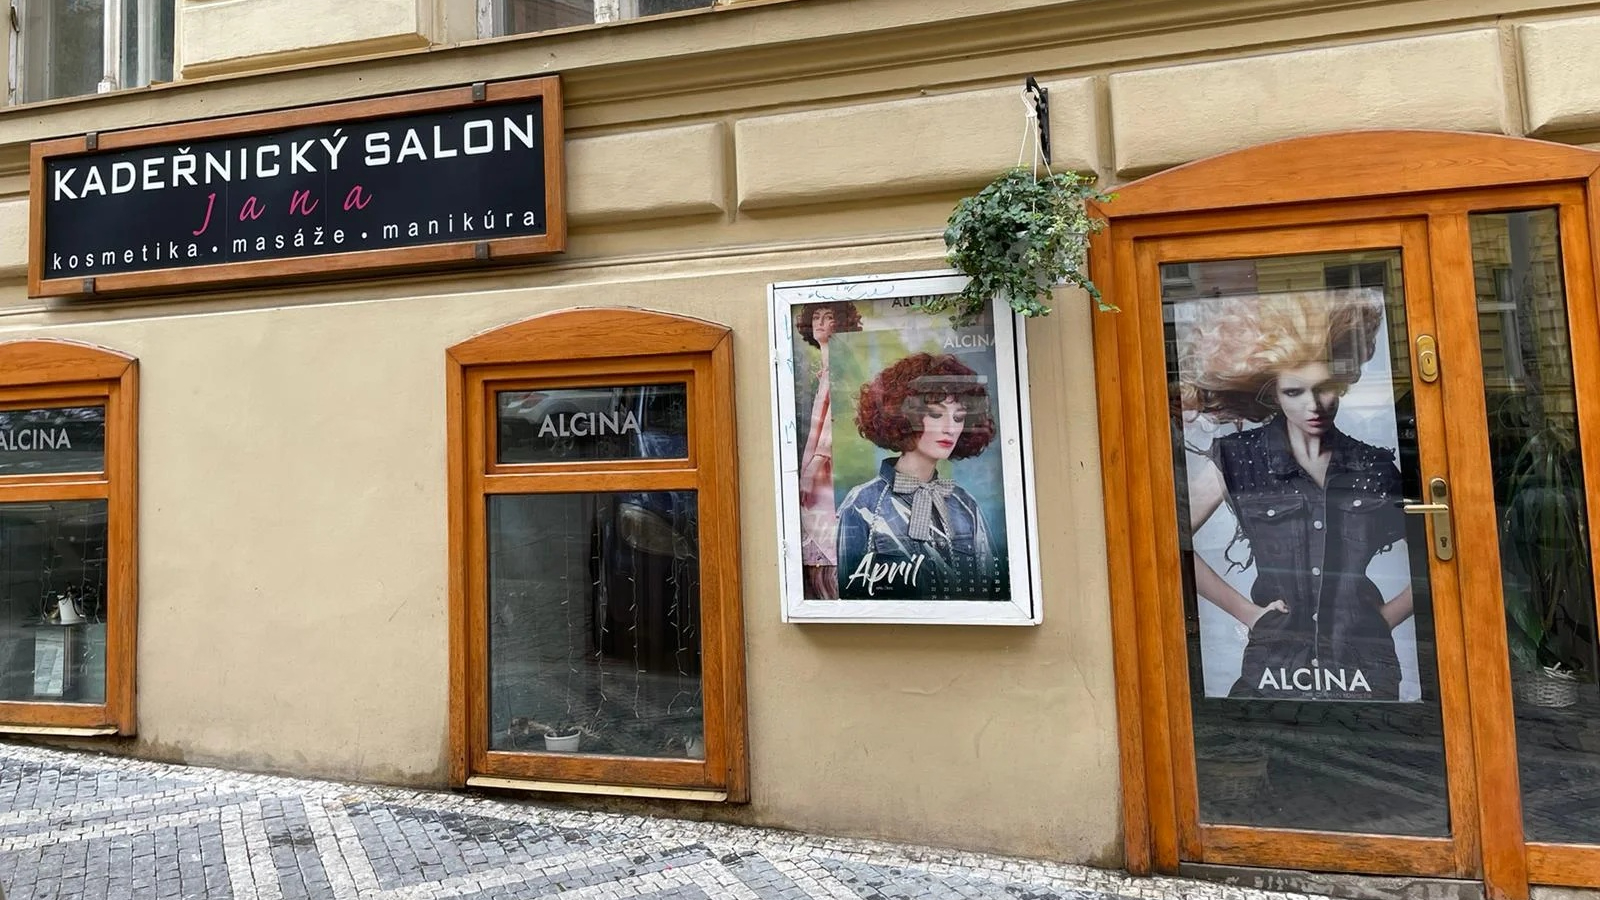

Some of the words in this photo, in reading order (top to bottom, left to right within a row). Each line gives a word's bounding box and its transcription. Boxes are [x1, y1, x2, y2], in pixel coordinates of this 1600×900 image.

[54, 128, 348, 201] KADEŘNICKÝ
[364, 114, 534, 167] SALON
[53, 241, 198, 270] kosmetika
[232, 227, 346, 254] masáže
[383, 210, 535, 240] manikúra
[537, 410, 641, 438] ALCINA
[845, 552, 925, 596] April
[1258, 667, 1372, 692] ALCINA
